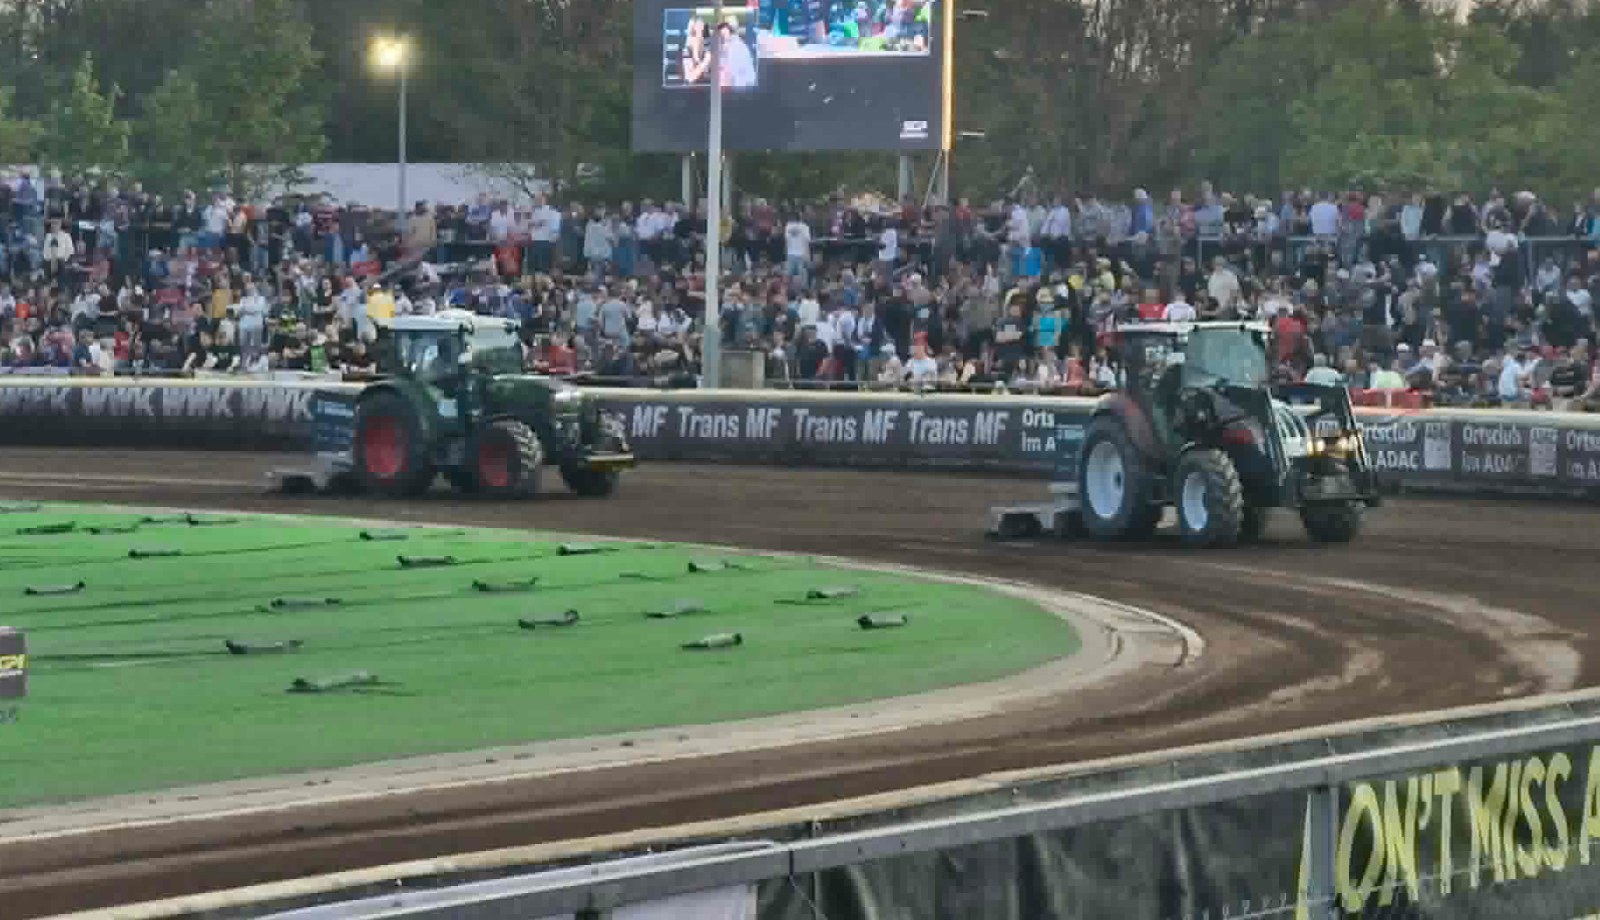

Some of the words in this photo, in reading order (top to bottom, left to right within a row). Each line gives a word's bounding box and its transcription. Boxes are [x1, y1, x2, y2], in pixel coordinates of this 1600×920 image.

[81, 387, 155, 415] WWK
[162, 387, 233, 417] WWK
[242, 387, 314, 420] WWK
[632, 405, 668, 438] MF
[677, 406, 740, 438] Trans
[745, 408, 782, 440] MF
[794, 408, 857, 442] Trans
[862, 410, 899, 443] MF
[908, 411, 969, 444] Trans
[974, 411, 1010, 445] MF
[1021, 408, 1055, 429] Orts
[1462, 423, 1521, 446] Ortsclub
[1376, 450, 1420, 470] ADAC
[1296, 766, 1461, 920] ON'T
[1468, 752, 1572, 890] MISS
